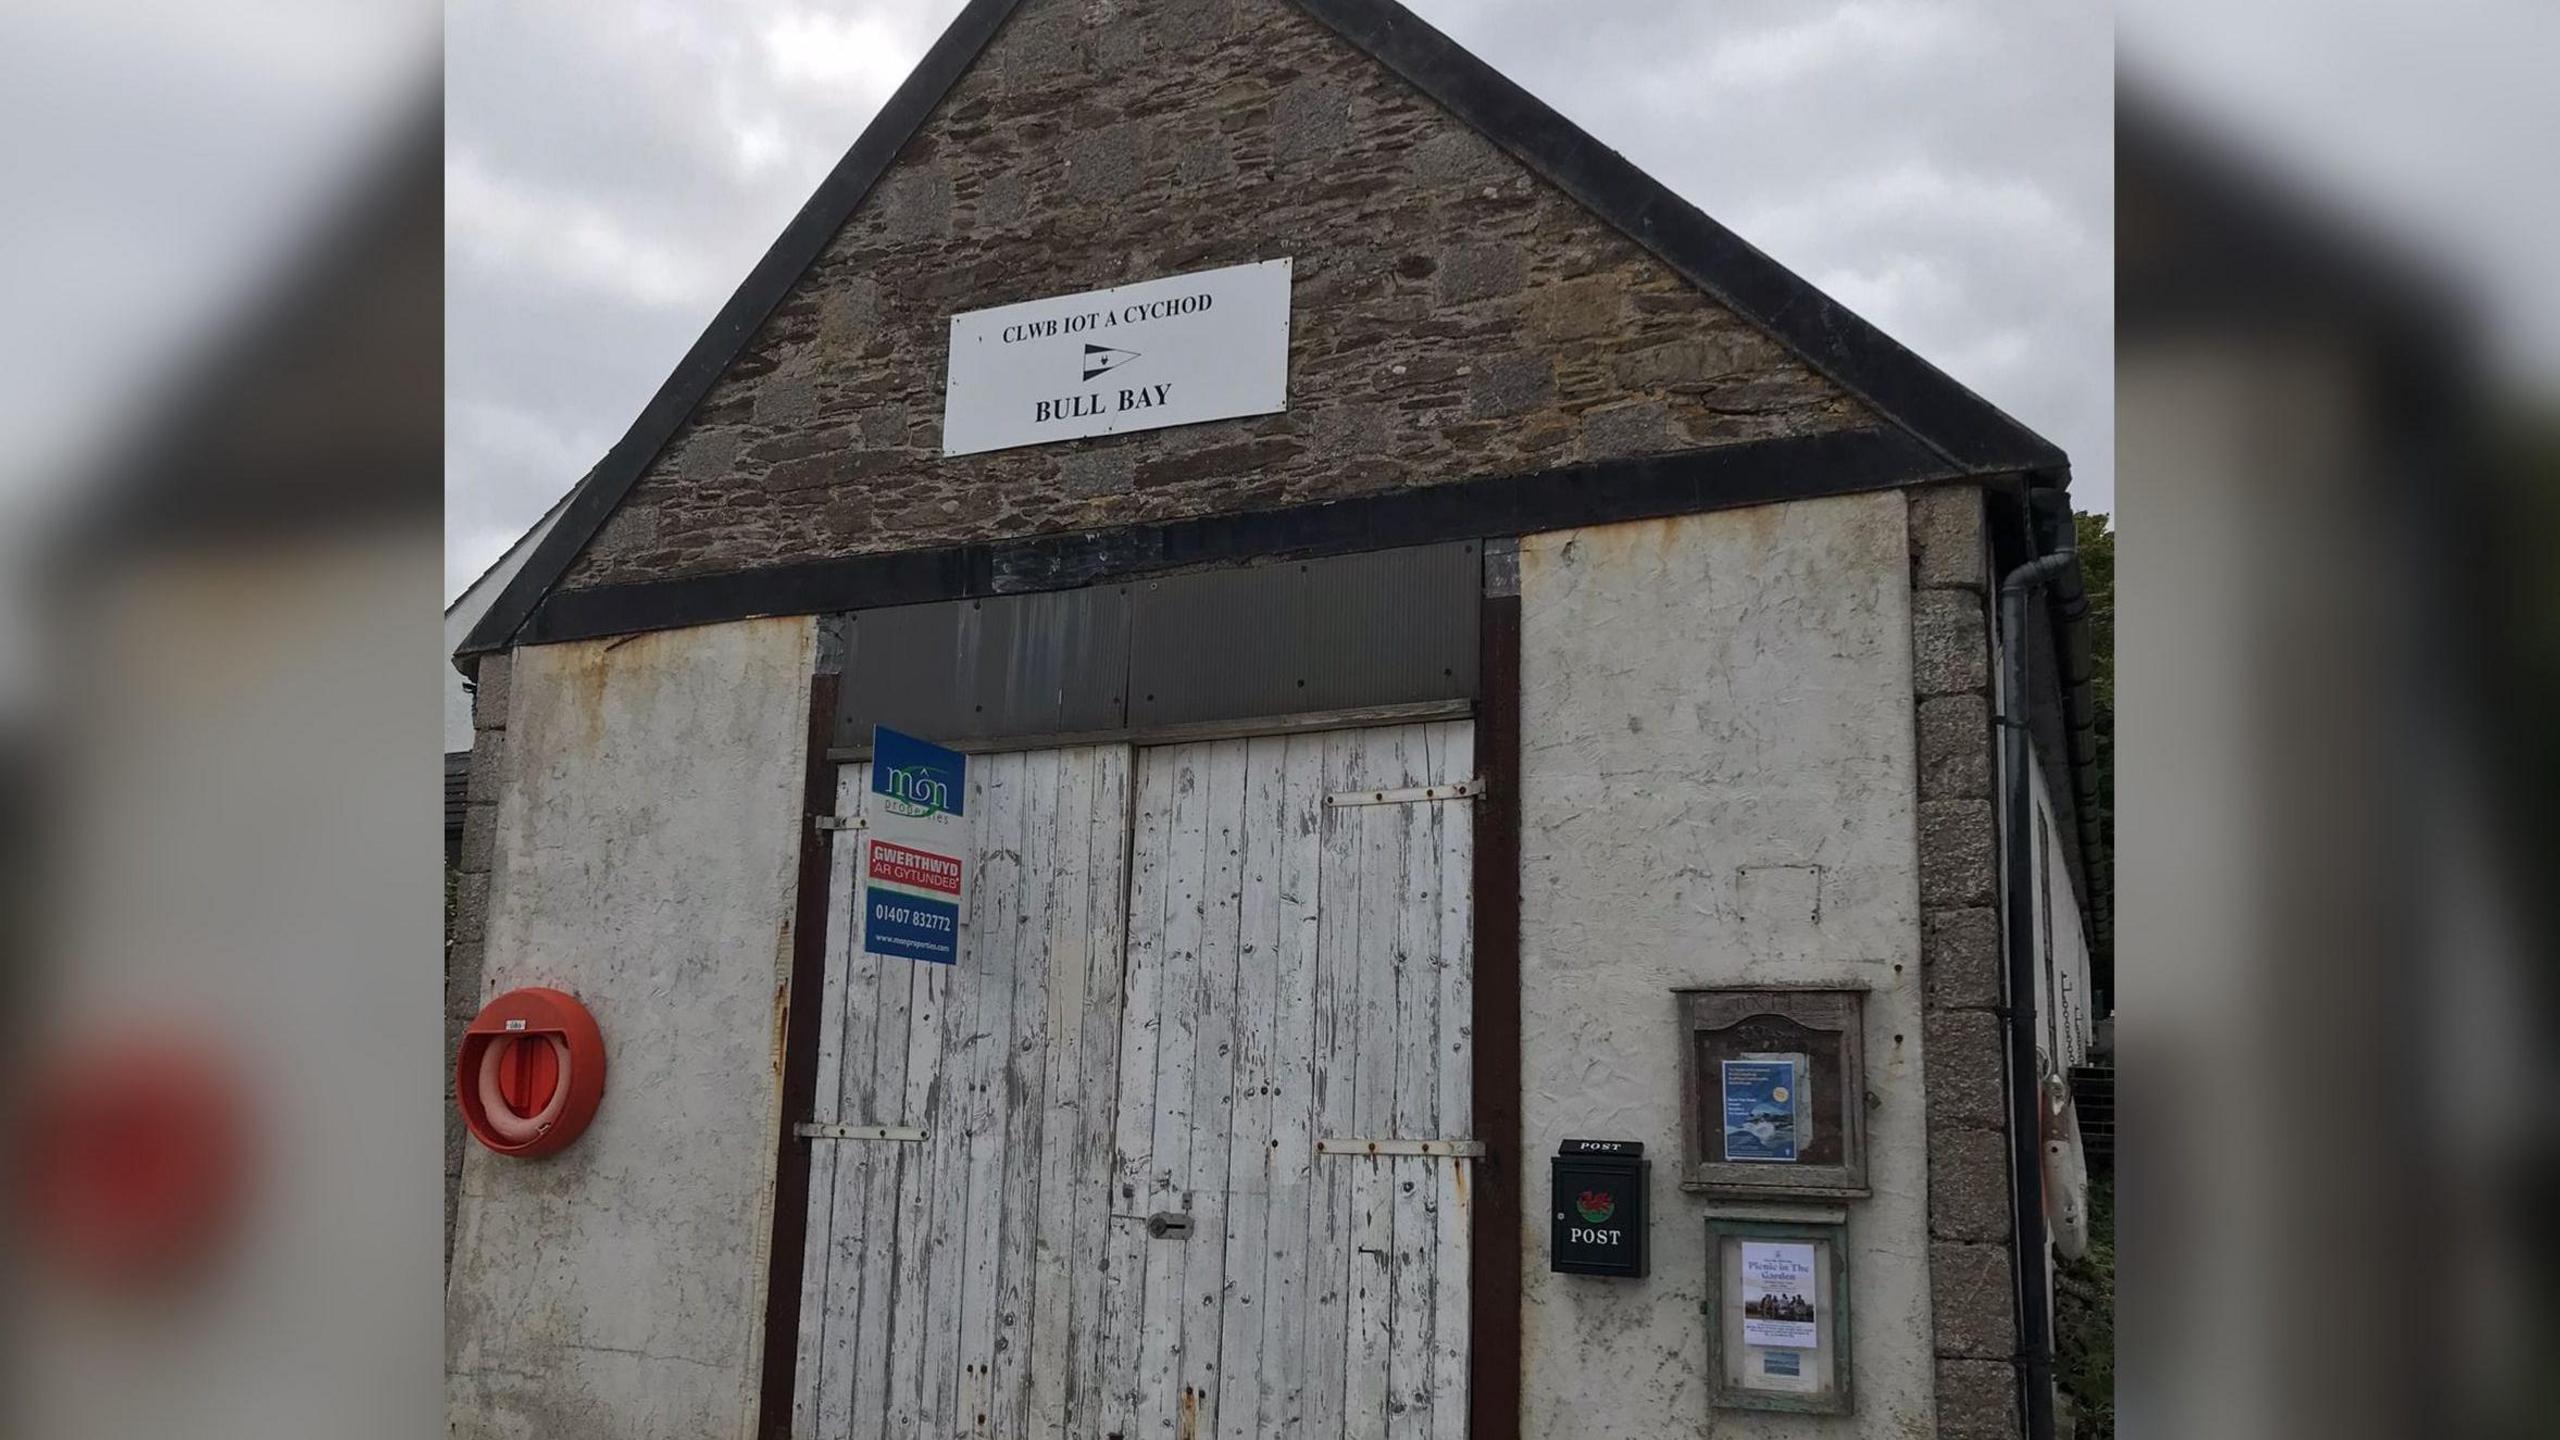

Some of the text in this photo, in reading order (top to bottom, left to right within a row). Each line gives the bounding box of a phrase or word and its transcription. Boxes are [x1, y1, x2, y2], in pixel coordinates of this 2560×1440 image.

[1003, 293, 1213, 344] CLWB IOT A CYCHOD
[1035, 383, 1173, 423] BULL BAY
[874, 846, 958, 877] GWERTHWYD
[874, 862, 957, 889] AR GYTUNDEB
[876, 903, 951, 932] 01407 832772
[1580, 1142, 1622, 1151] POST
[1571, 1228, 1621, 1246] POST
